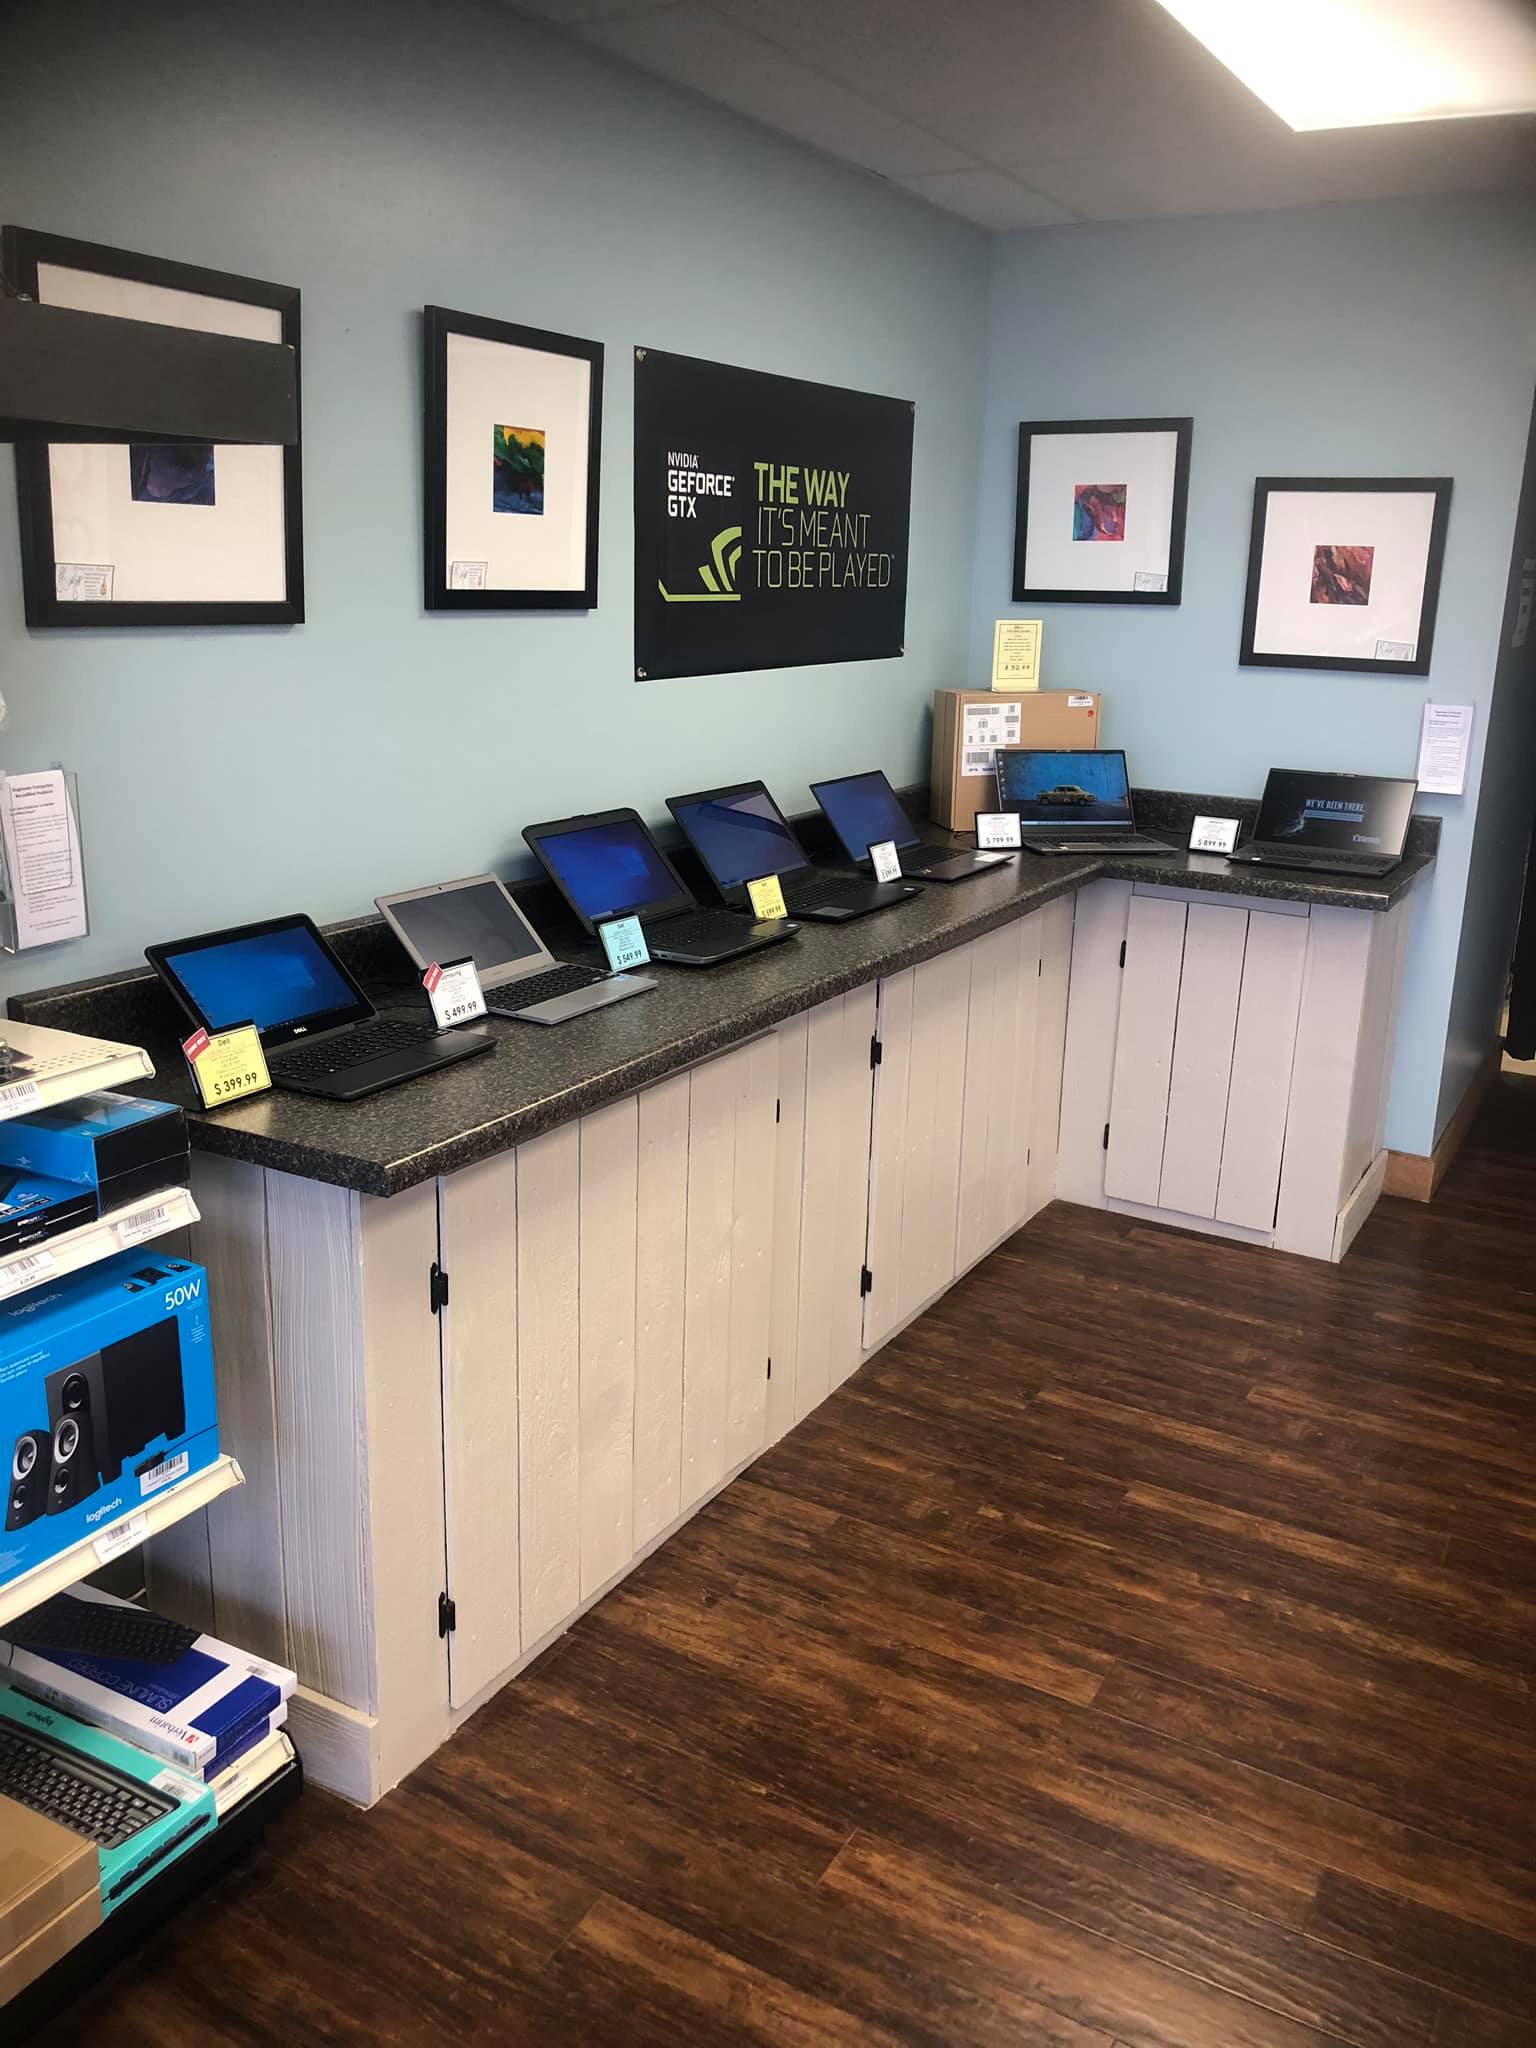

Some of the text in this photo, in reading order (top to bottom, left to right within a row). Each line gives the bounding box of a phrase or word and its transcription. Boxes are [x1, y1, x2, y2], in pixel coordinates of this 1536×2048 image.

[668, 452, 698, 469] NVIDIA
[668, 470, 733, 497] GEFORCE
[754, 462, 850, 508] THE WAY
[668, 495, 698, 518] GTX
[758, 507, 871, 549] IT'S MEANT
[752, 550, 892, 589] TO BE PLAYED
[1326, 800, 1343, 811] BEEN
[452, 1001, 477, 1017] 499.99
[218, 1038, 231, 1047] Dell
[223, 1072, 257, 1092] 399.99
[165, 1279, 201, 1310] 50W
[86, 1497, 122, 1524] logitech
[149, 1716, 188, 1740] Verbatim
